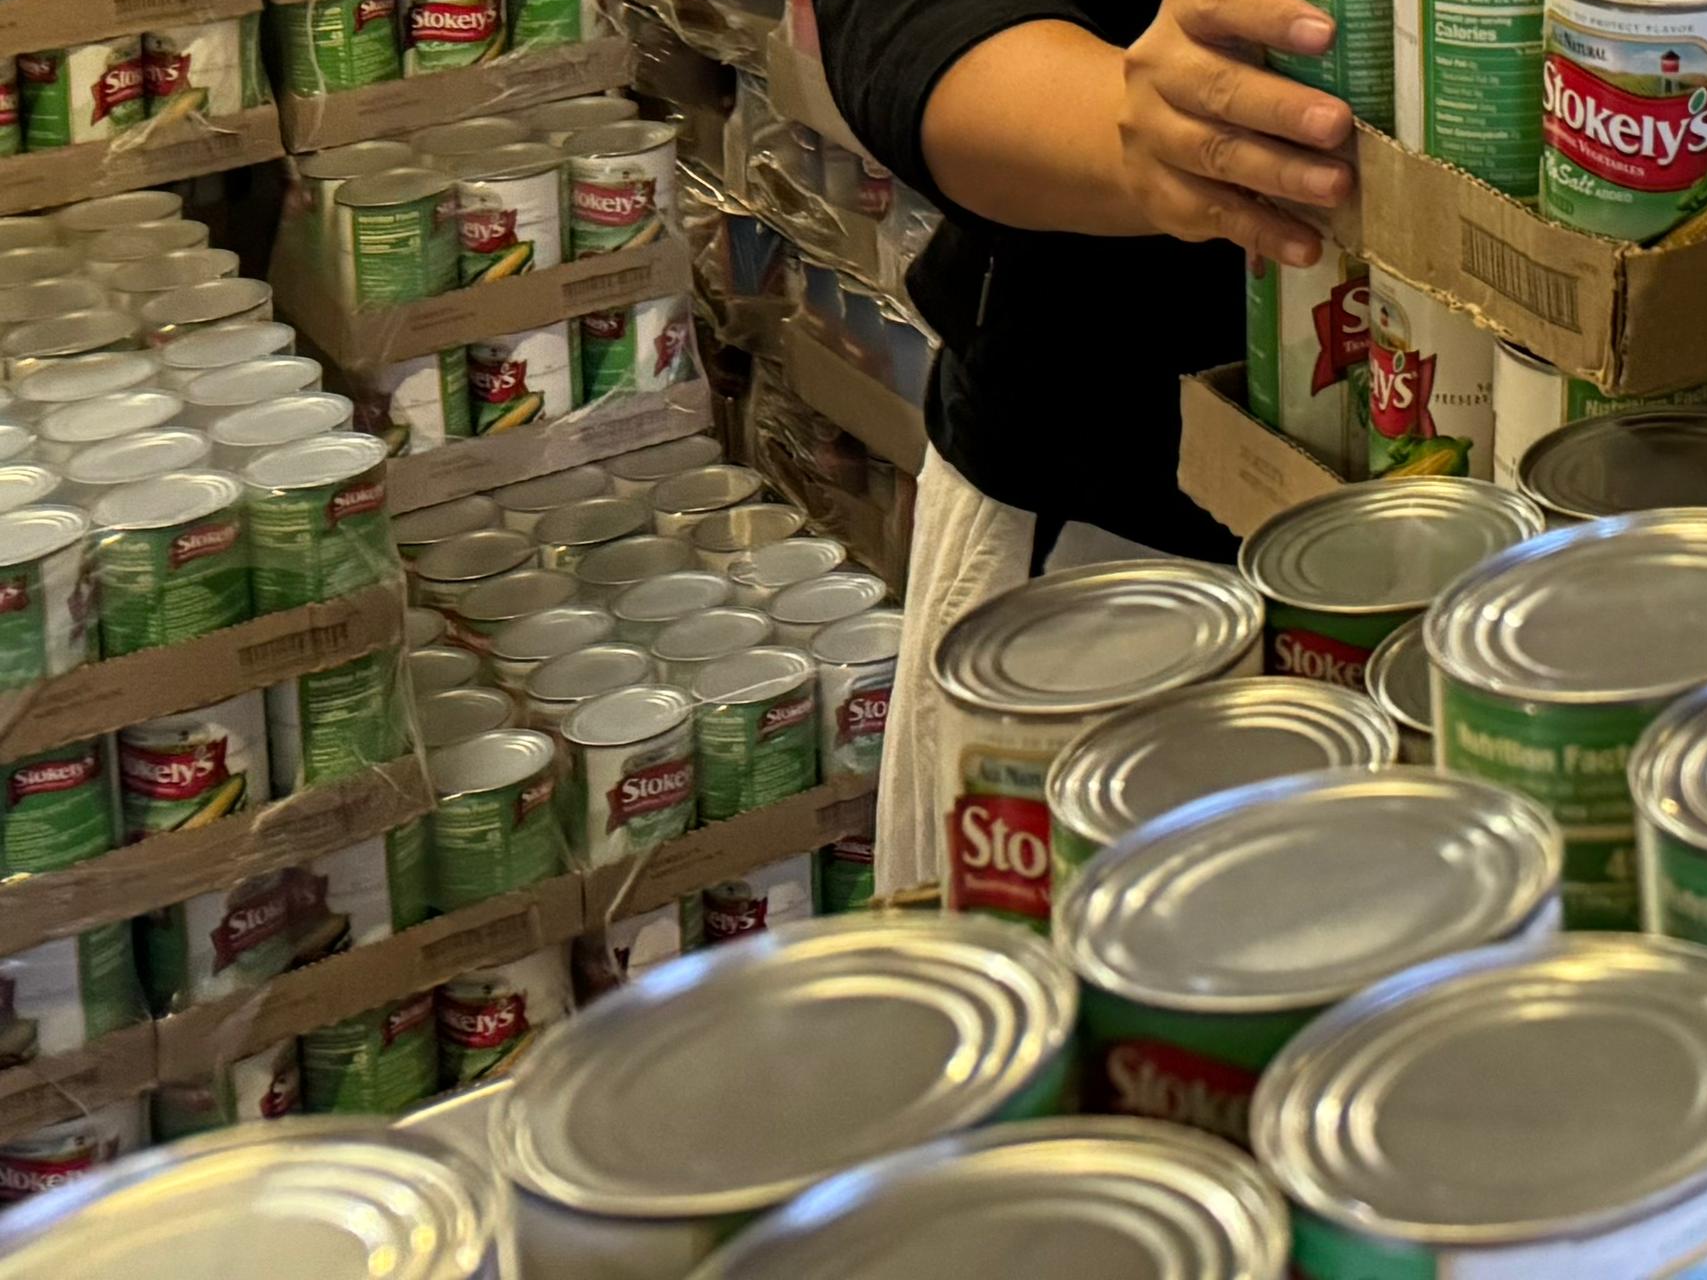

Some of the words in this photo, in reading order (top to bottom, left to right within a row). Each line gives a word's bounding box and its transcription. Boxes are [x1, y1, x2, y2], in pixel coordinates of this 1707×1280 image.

[1434, 20, 1497, 42] Calories
[1646, 21, 1696, 35] FLAVOR
[1557, 164, 1596, 194] Salt
[961, 806, 1047, 880] Sto
